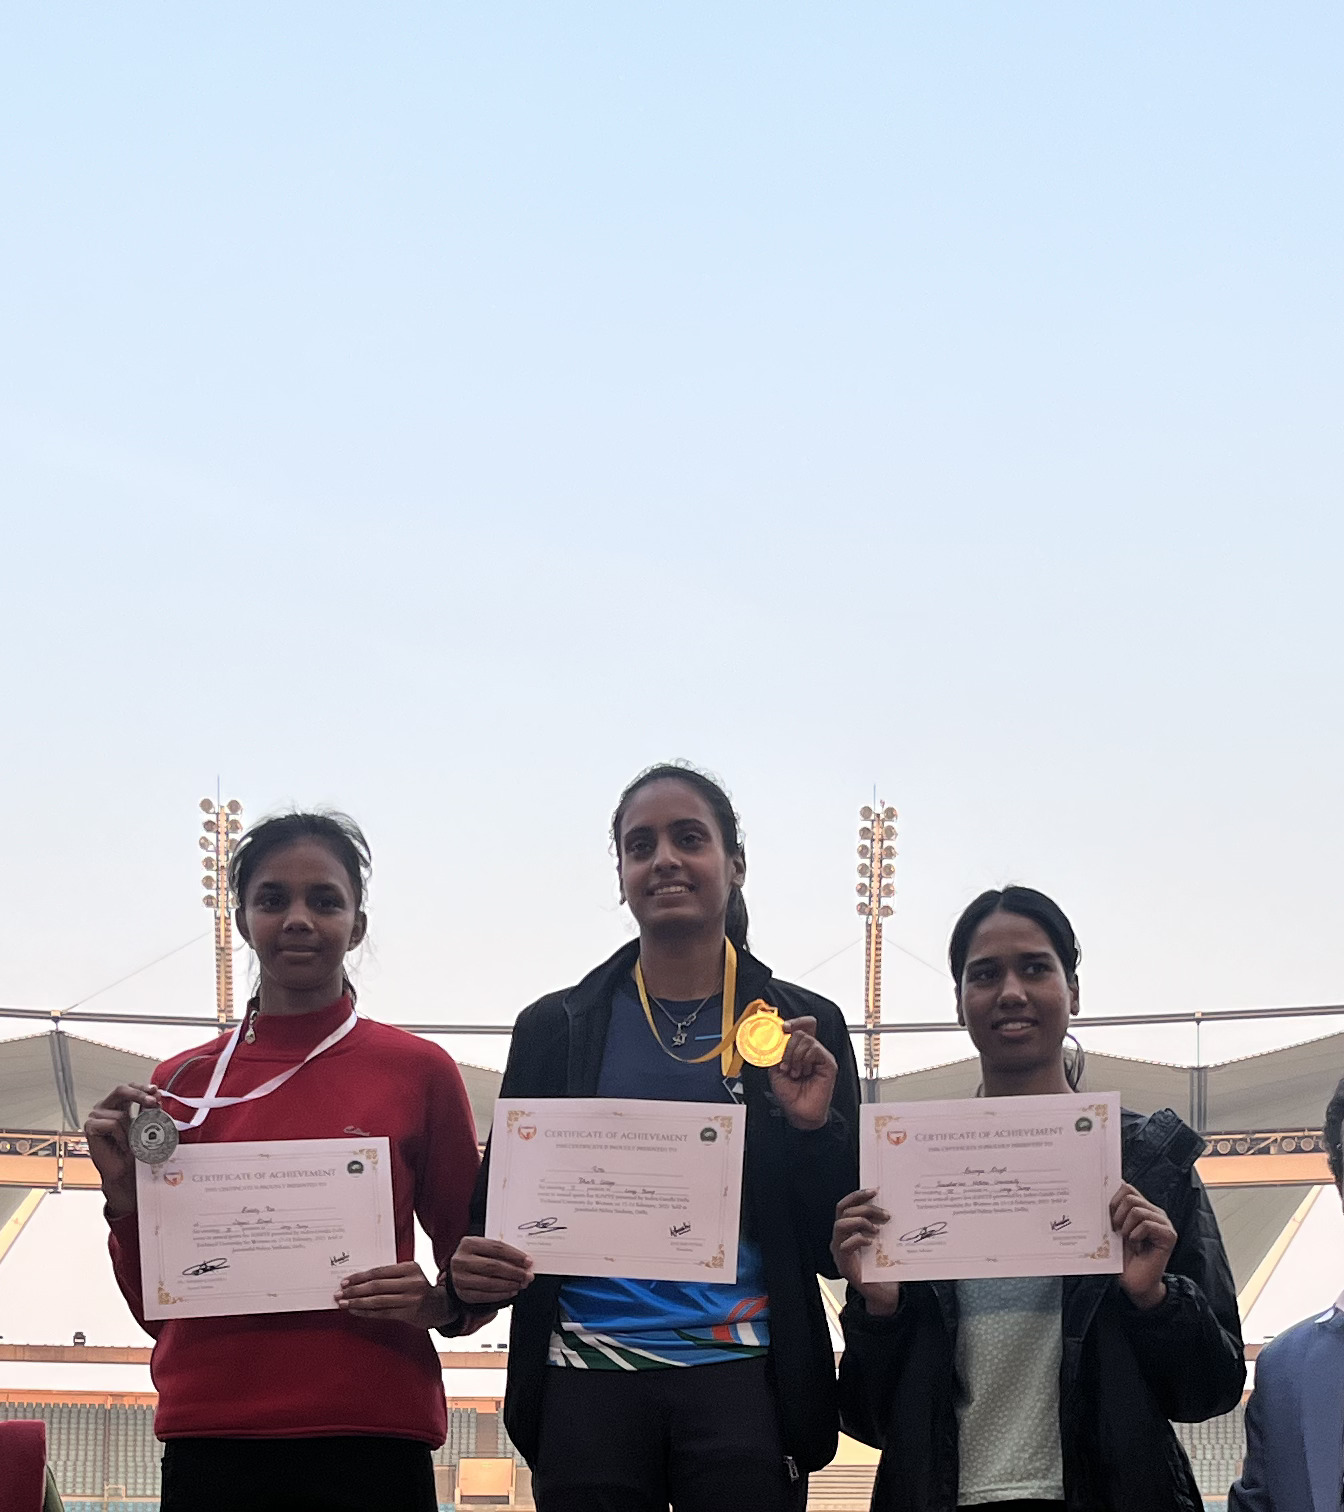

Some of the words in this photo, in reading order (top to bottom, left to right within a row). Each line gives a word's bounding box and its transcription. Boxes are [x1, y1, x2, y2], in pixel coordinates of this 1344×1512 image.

[544, 1129, 602, 1140] CERTIFICATE
[605, 1130, 618, 1140] OF
[620, 1131, 688, 1143] ACHIEVEMENT
[914, 1131, 977, 1143] CERTIFICATE
[978, 1130, 991, 1139] OF
[994, 1126, 1064, 1139] ACHIEVEMENT
[192, 1172, 253, 1183] CERTIFICATE
[254, 1171, 266, 1180] OF
[269, 1168, 336, 1180] ACHIEVEMENT
